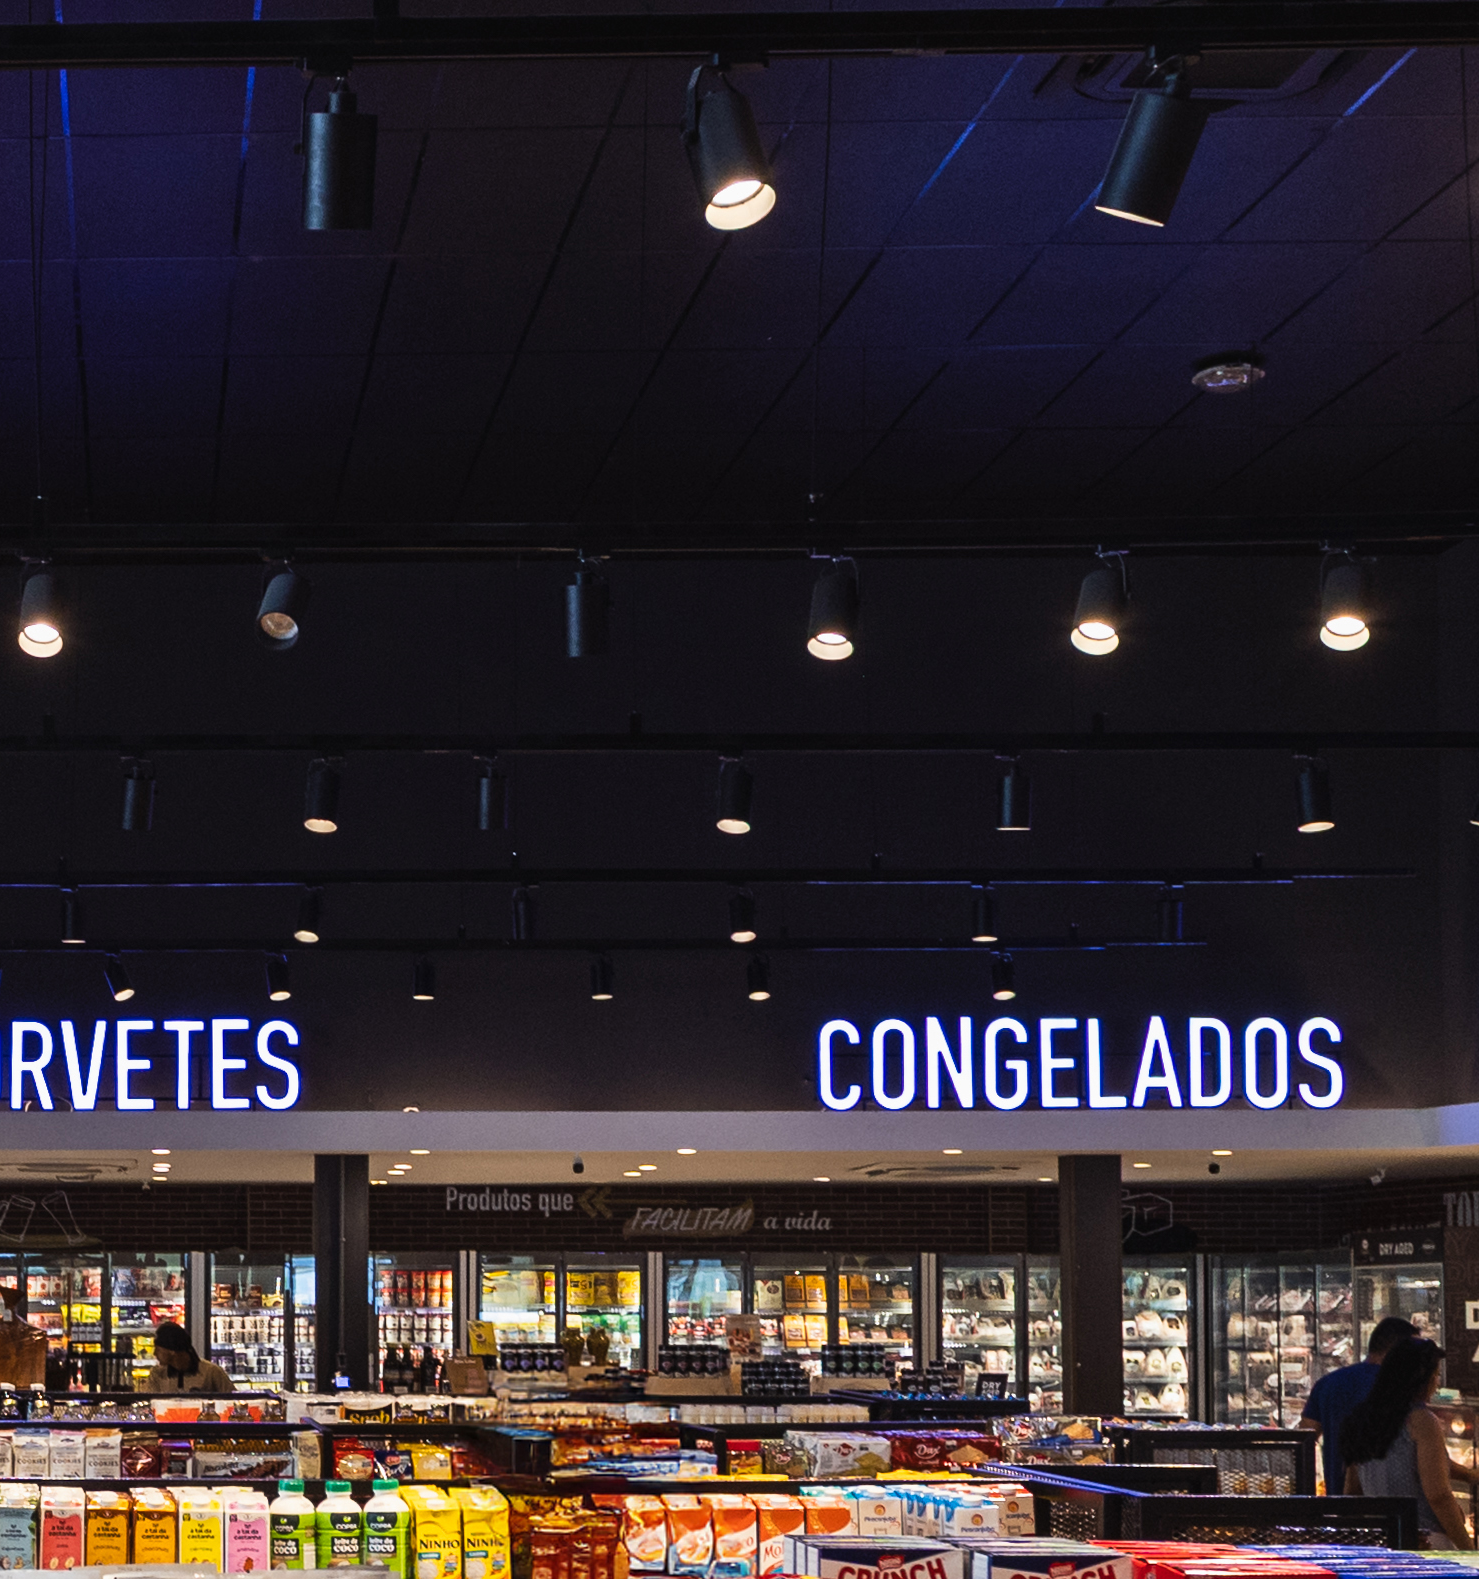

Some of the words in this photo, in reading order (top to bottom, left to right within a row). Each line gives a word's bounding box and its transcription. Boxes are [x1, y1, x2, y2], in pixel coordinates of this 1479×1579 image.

[819, 1016, 1344, 1109] CONGELADOS
[446, 1187, 531, 1212] Produtos
[539, 1192, 573, 1217] que
[629, 1208, 752, 1231] FACILITAM
[764, 1217, 778, 1230] a
[785, 1211, 832, 1230] vida
[1379, 1243, 1393, 1255] DRY
[1395, 1242, 1413, 1255] AGED
[982, 1381, 1001, 1389] DRY
[419, 1539, 460, 1550] NINHO
